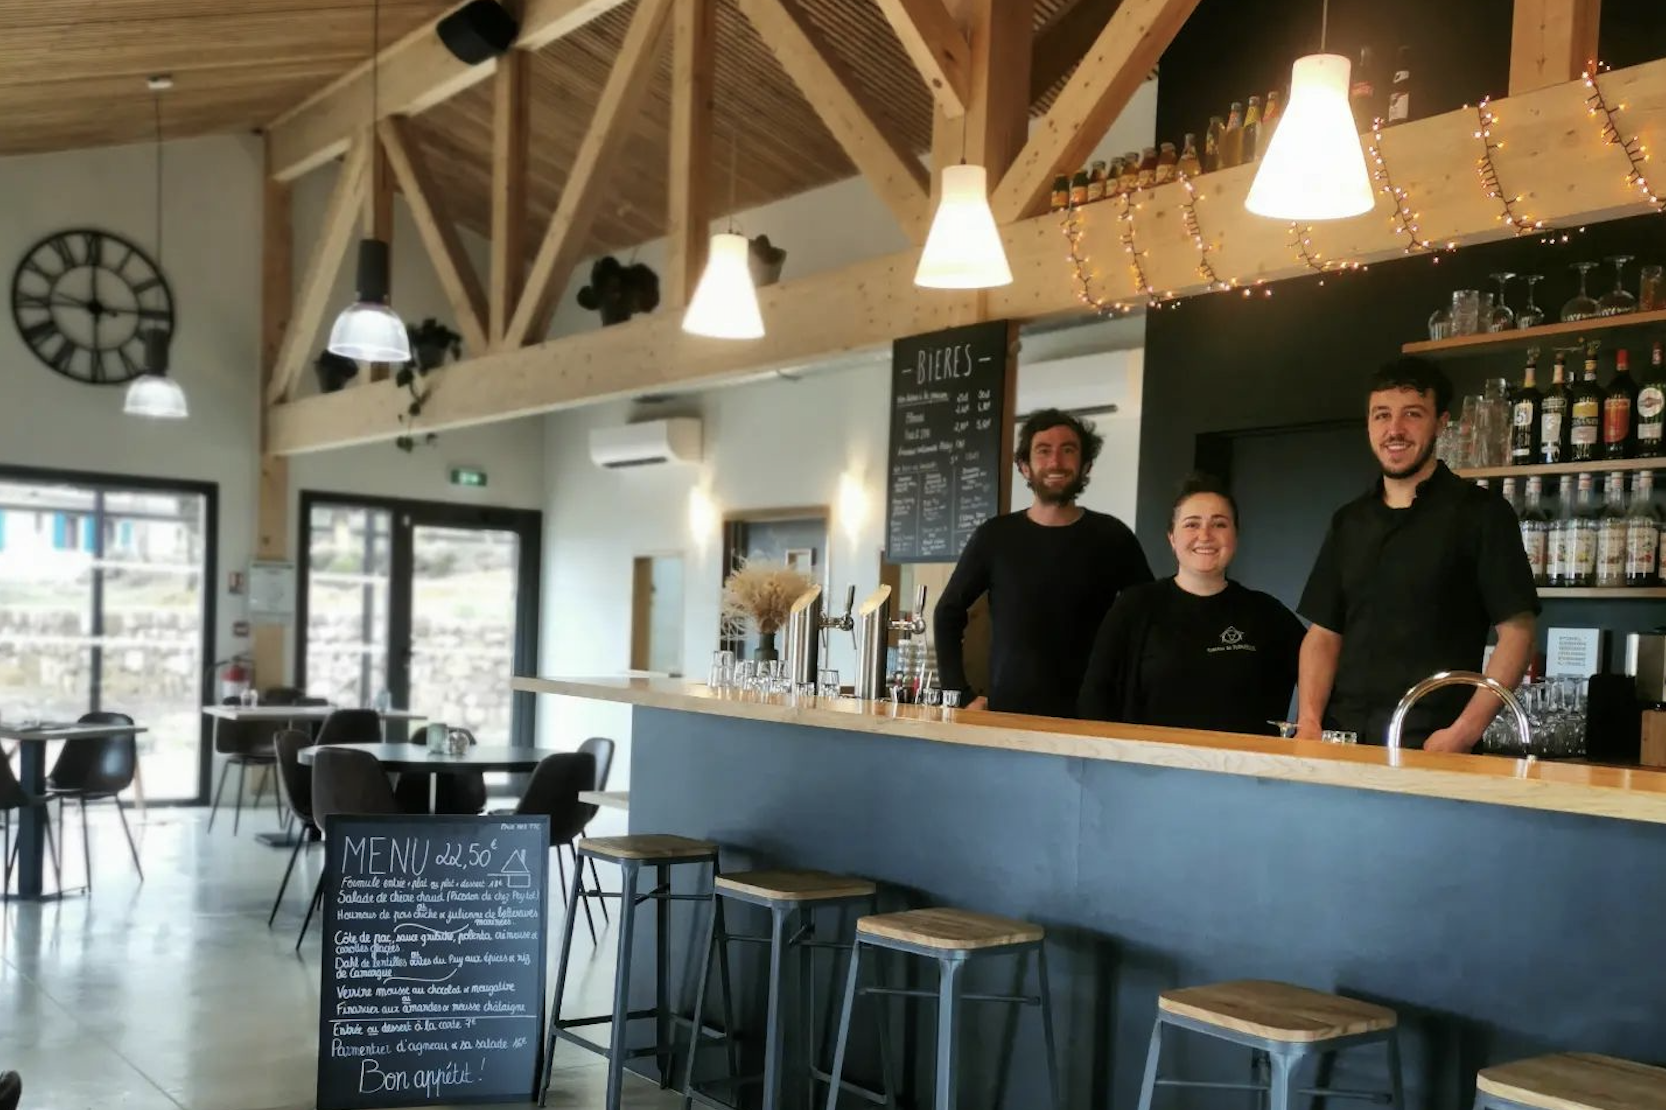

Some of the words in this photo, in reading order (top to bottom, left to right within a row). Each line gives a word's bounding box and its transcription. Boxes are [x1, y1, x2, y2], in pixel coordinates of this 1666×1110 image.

[341, 835, 430, 876] MENU
[340, 875, 380, 889] Formule
[337, 889, 374, 904] Salade
[376, 891, 388, 902] de
[416, 891, 445, 902] chaud
[379, 909, 391, 920] de
[393, 910, 412, 923] pois
[413, 909, 438, 919] chiche
[446, 908, 483, 924] julienne
[484, 908, 496, 919] de
[497, 905, 539, 919] betteraves
[333, 930, 358, 946] Côte
[359, 931, 371, 943] de
[396, 933, 418, 942] sauce
[433, 955, 447, 965] du
[448, 954, 464, 968] Puy
[335, 969, 347, 980] de
[349, 968, 392, 981] Camargue
[375, 986, 411, 997] mousse
[411, 987, 425, 995] au
[427, 984, 462, 994] chocolat
[381, 1005, 400, 1014] aux
[402, 1002, 442, 1014] amandes
[452, 1002, 481, 1011] mousse
[333, 1022, 364, 1036] Entrée
[381, 1022, 412, 1034] dessert
[424, 1020, 437, 1032] la
[438, 1019, 462, 1031] carte
[331, 1037, 393, 1058] Parmentier
[460, 1040, 473, 1050] sa
[475, 1037, 509, 1049] salade
[359, 1058, 410, 1094] Bon
[413, 1061, 474, 1099] appétit
